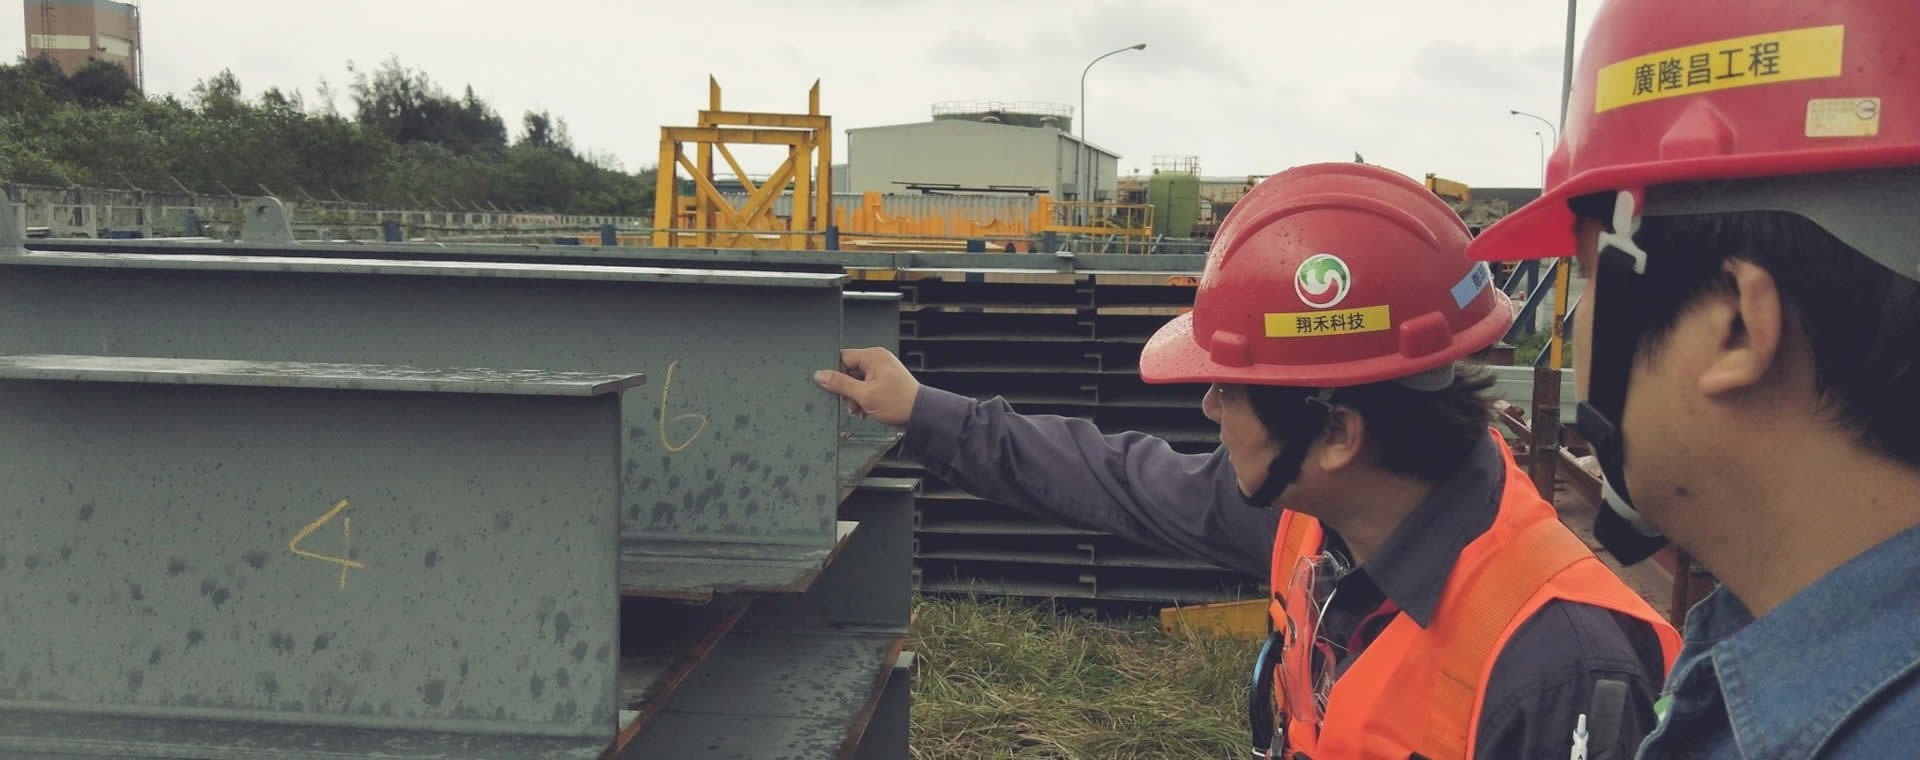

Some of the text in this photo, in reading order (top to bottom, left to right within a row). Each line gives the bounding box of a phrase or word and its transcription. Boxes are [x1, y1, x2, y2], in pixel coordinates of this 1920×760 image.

[1632, 41, 1780, 96] 廣隆昌工程
[1296, 312, 1365, 333] 翔禾科技
[659, 359, 707, 452] 6
[289, 499, 366, 591] 4
